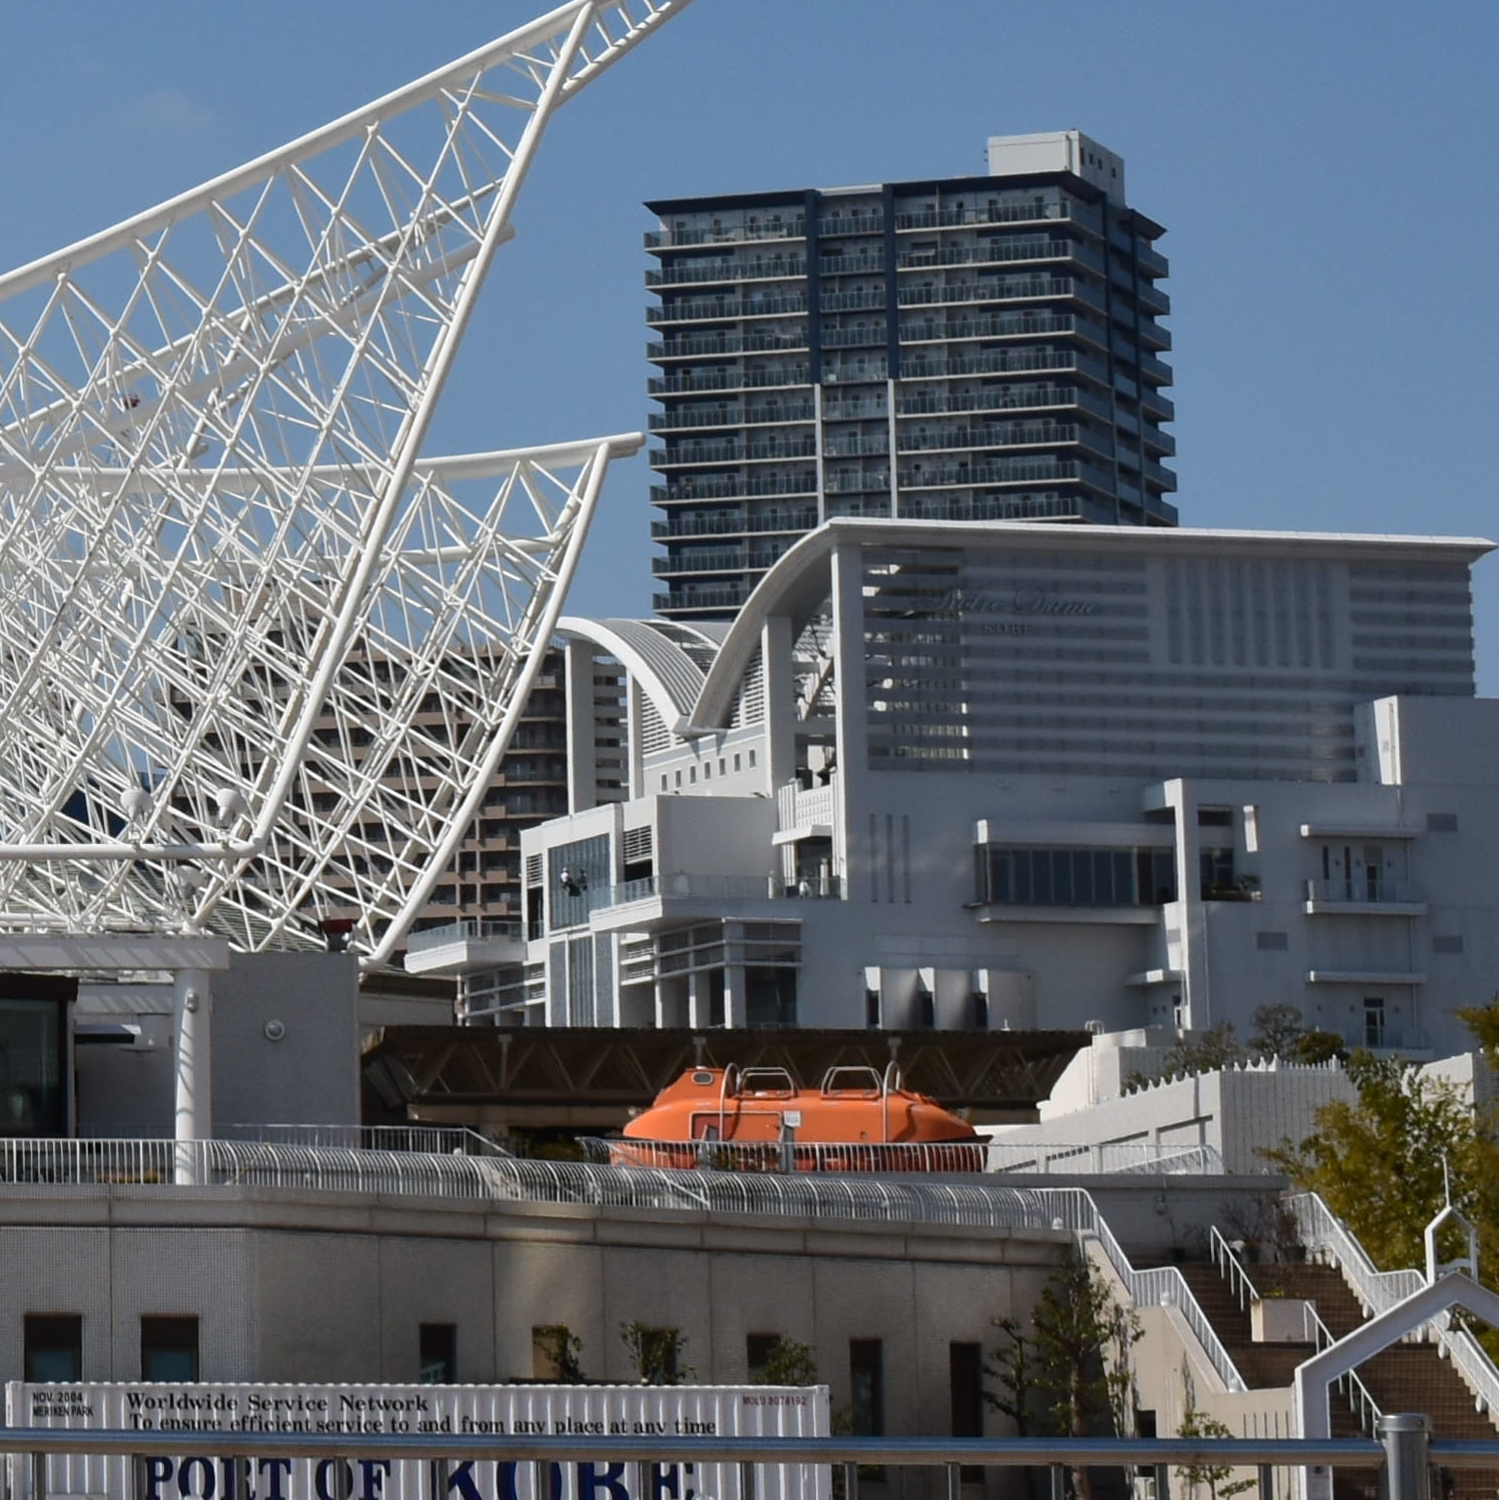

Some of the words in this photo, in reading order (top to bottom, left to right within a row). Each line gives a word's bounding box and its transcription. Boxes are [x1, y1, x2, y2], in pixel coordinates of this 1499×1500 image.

[58, 1391, 83, 1403] 2004
[126, 1392, 238, 1411] Worldwide
[248, 1393, 328, 1411] Service
[339, 1394, 429, 1412] Network
[33, 1405, 69, 1417] MERIKEN
[71, 1405, 94, 1417] PARK
[129, 1412, 153, 1430] To
[160, 1417, 222, 1430] ensure
[230, 1414, 310, 1432] efficient
[316, 1416, 384, 1432] service
[390, 1417, 409, 1433] to
[418, 1416, 451, 1433] and
[462, 1416, 504, 1434] from
[513, 1420, 546, 1434] any
[555, 1417, 604, 1435] place
[610, 1418, 628, 1435] at
[633, 1420, 666, 1435] any
[675, 1417, 716, 1434] time
[145, 1456, 292, 1500] PORT
[315, 1458, 391, 1500] OF
